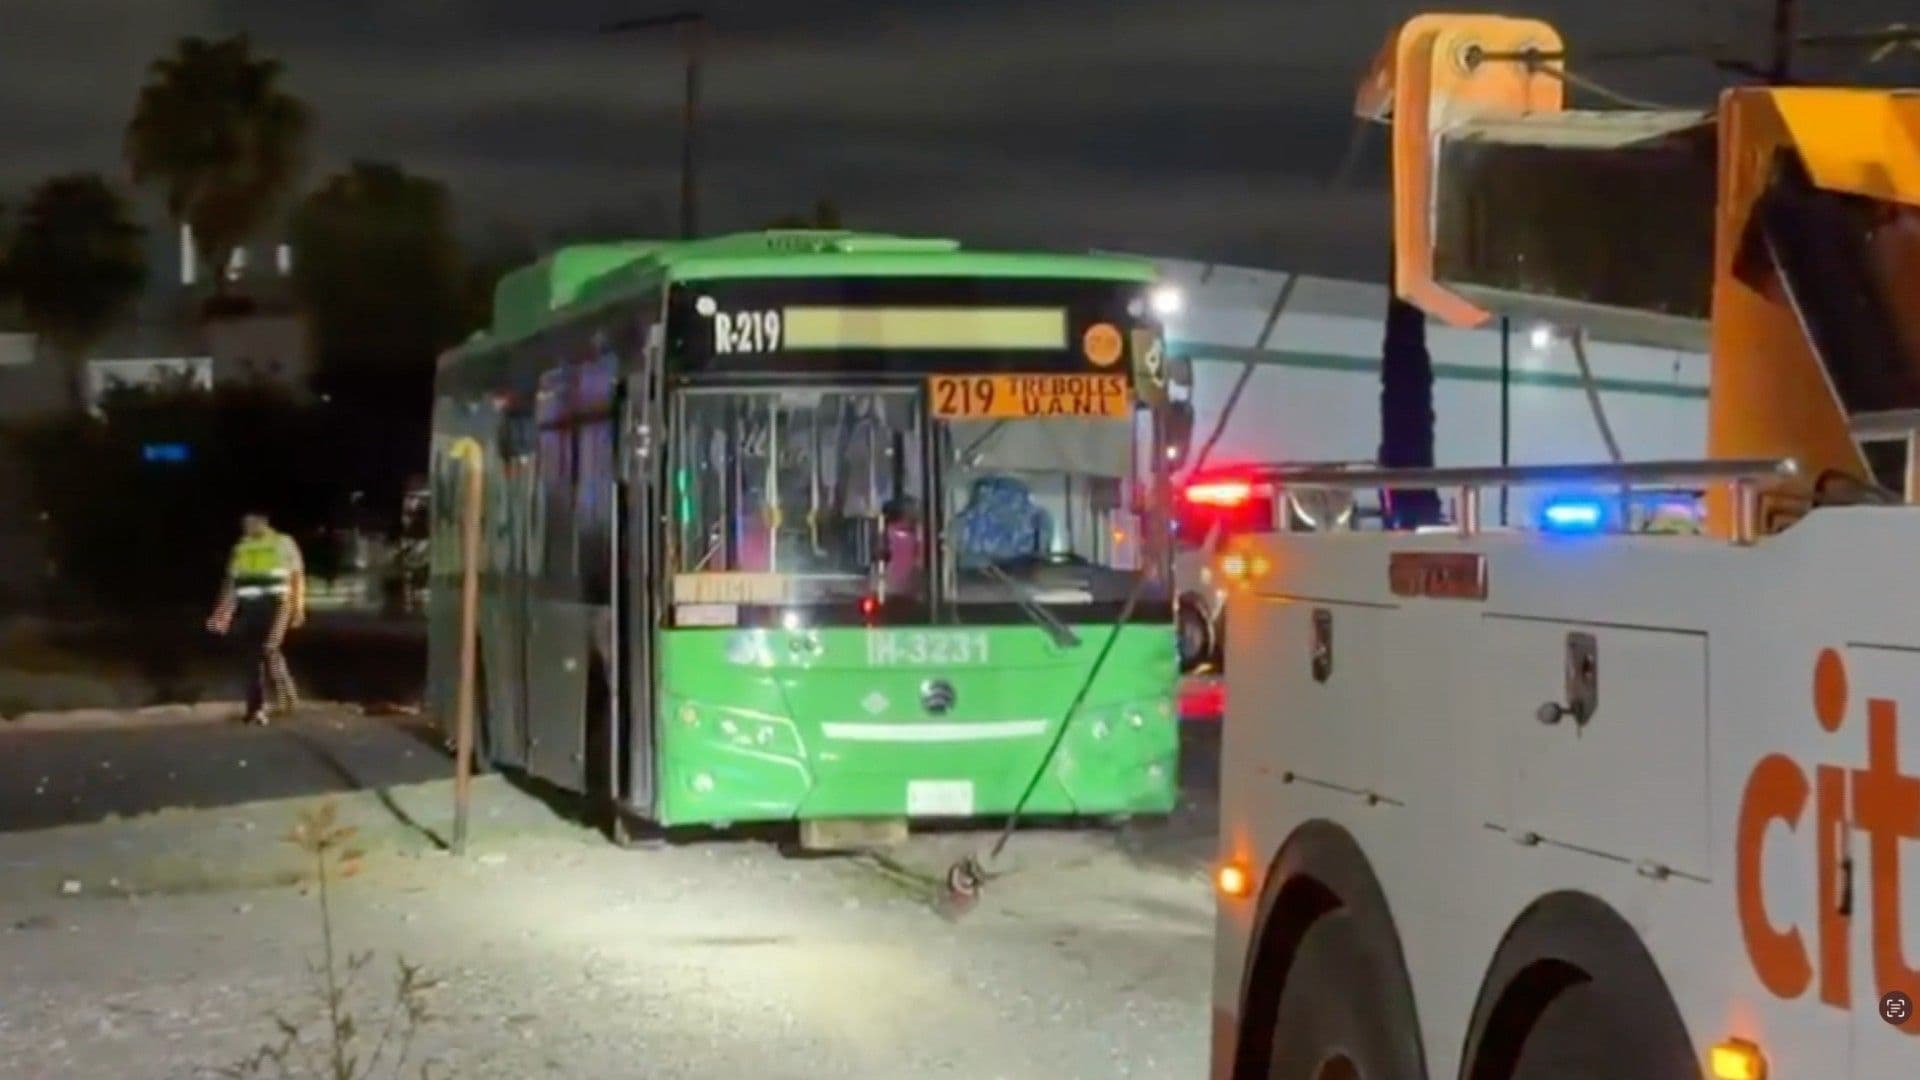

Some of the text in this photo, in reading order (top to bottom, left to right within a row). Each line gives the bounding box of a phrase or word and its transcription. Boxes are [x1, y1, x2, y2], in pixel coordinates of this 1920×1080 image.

[715, 311, 780, 353] R-219
[938, 378, 995, 415] 219
[1007, 376, 1122, 396] TREBOLES
